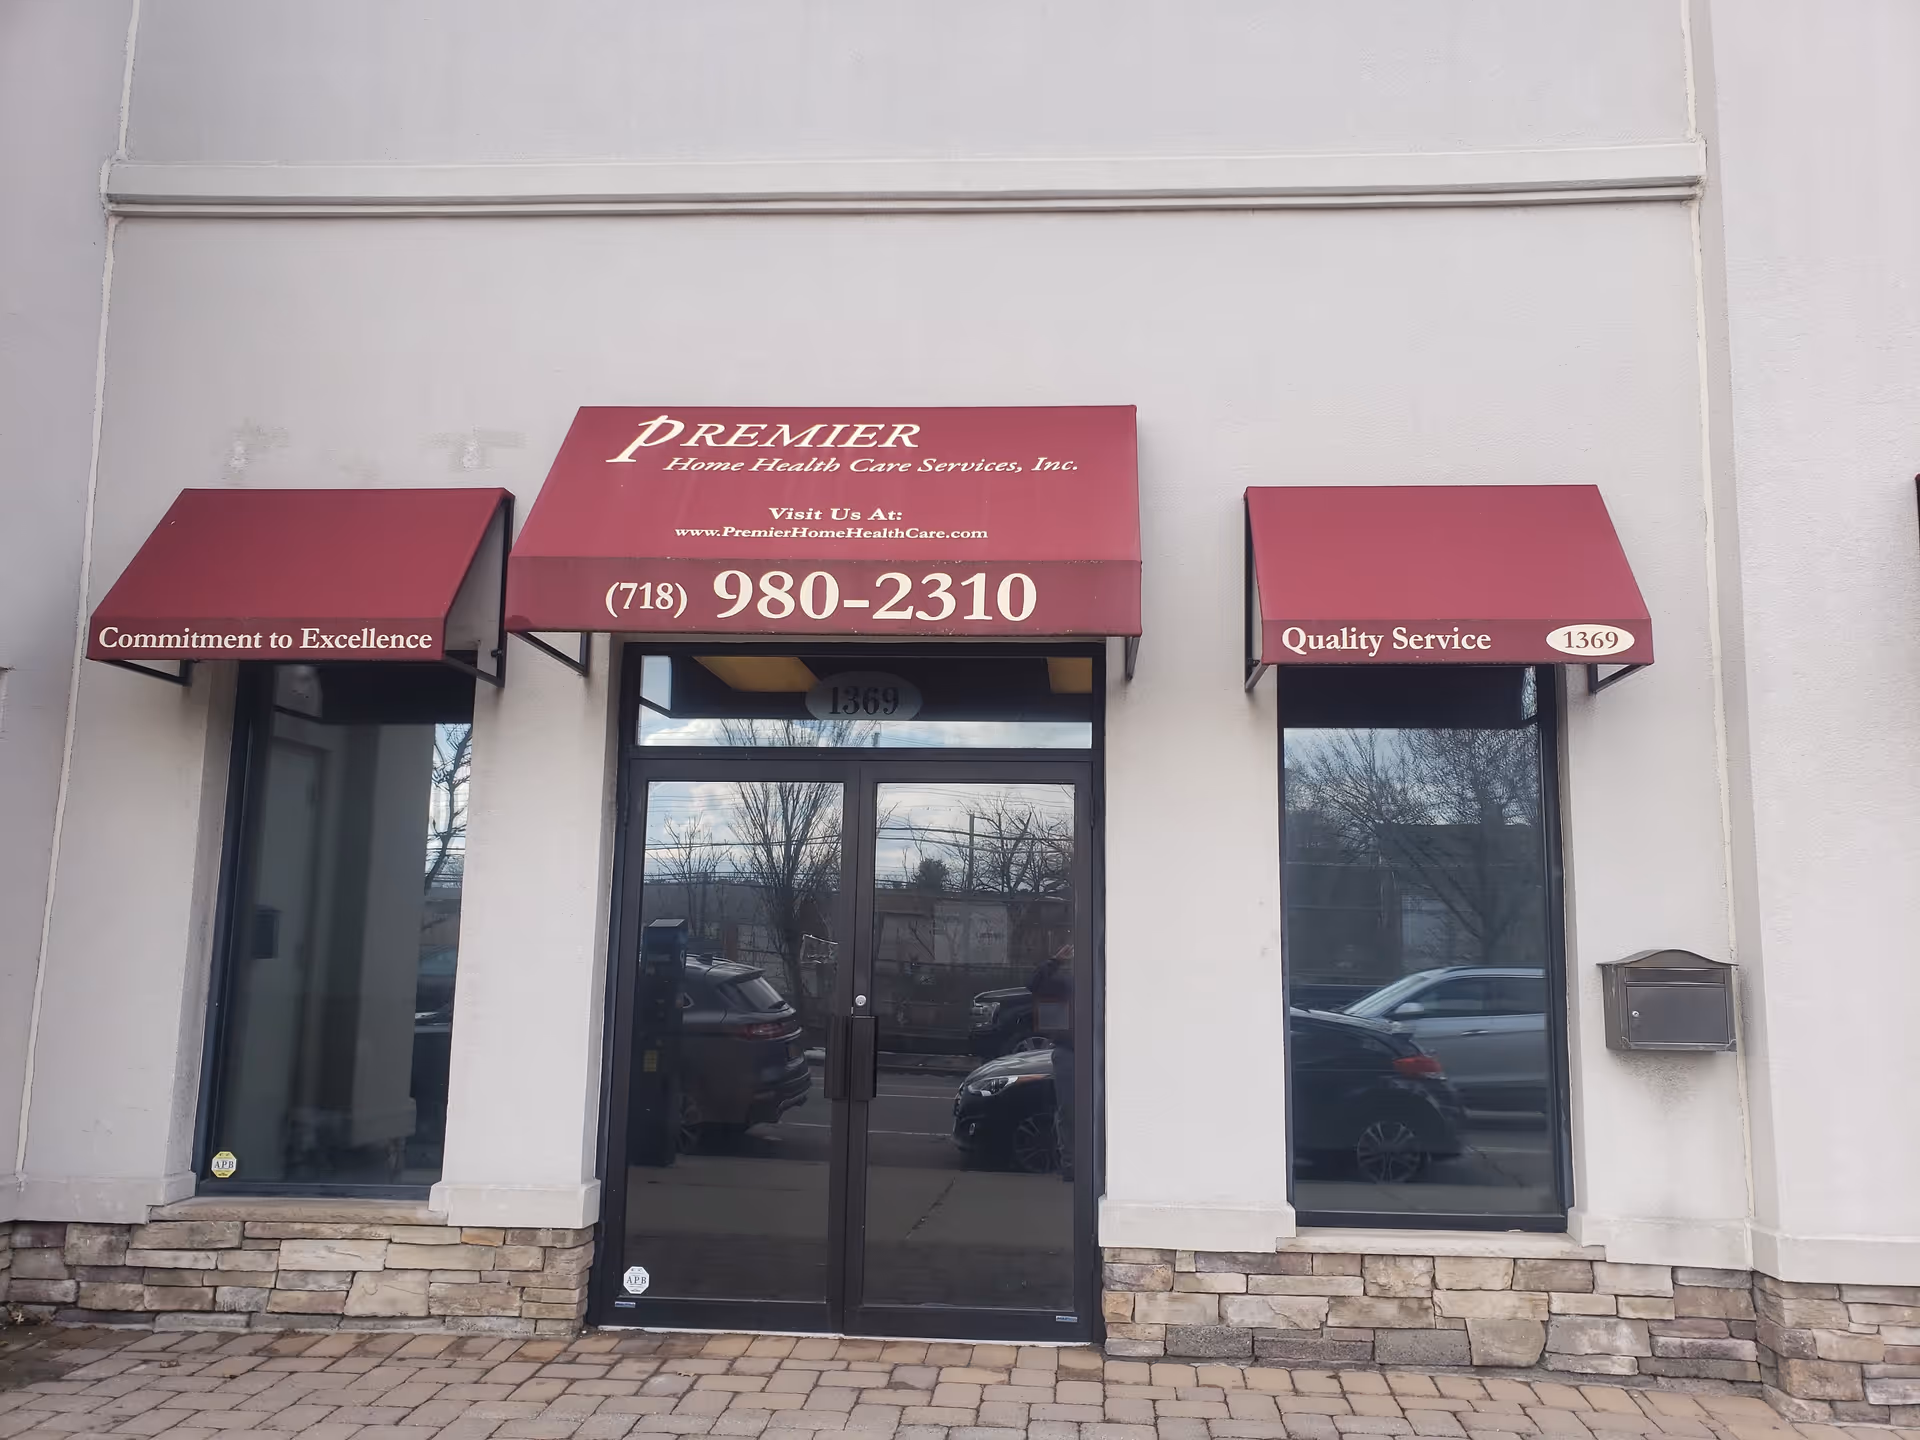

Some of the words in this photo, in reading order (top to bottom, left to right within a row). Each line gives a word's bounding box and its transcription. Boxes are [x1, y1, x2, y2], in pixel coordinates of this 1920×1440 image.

[605, 414, 921, 463] PREMIER
[662, 457, 745, 472] Home
[748, 457, 841, 472] Health
[849, 458, 912, 473] Care
[916, 458, 1023, 474] Services,
[1030, 457, 1078, 471] Inc.
[768, 507, 823, 520] Visit
[830, 508, 861, 521] Us
[867, 507, 903, 521] At:
[675, 526, 988, 539] www.PremierHomeHealthCare.com
[605, 581, 688, 619] (718)
[713, 570, 1037, 622] 980-2310
[99, 626, 262, 649] Commitment
[270, 631, 292, 649] to
[299, 627, 432, 649] Excellence
[1281, 626, 1384, 657] Quality
[1392, 626, 1491, 650] Service
[1564, 631, 1619, 649] 1369
[829, 686, 899, 715] 1369
